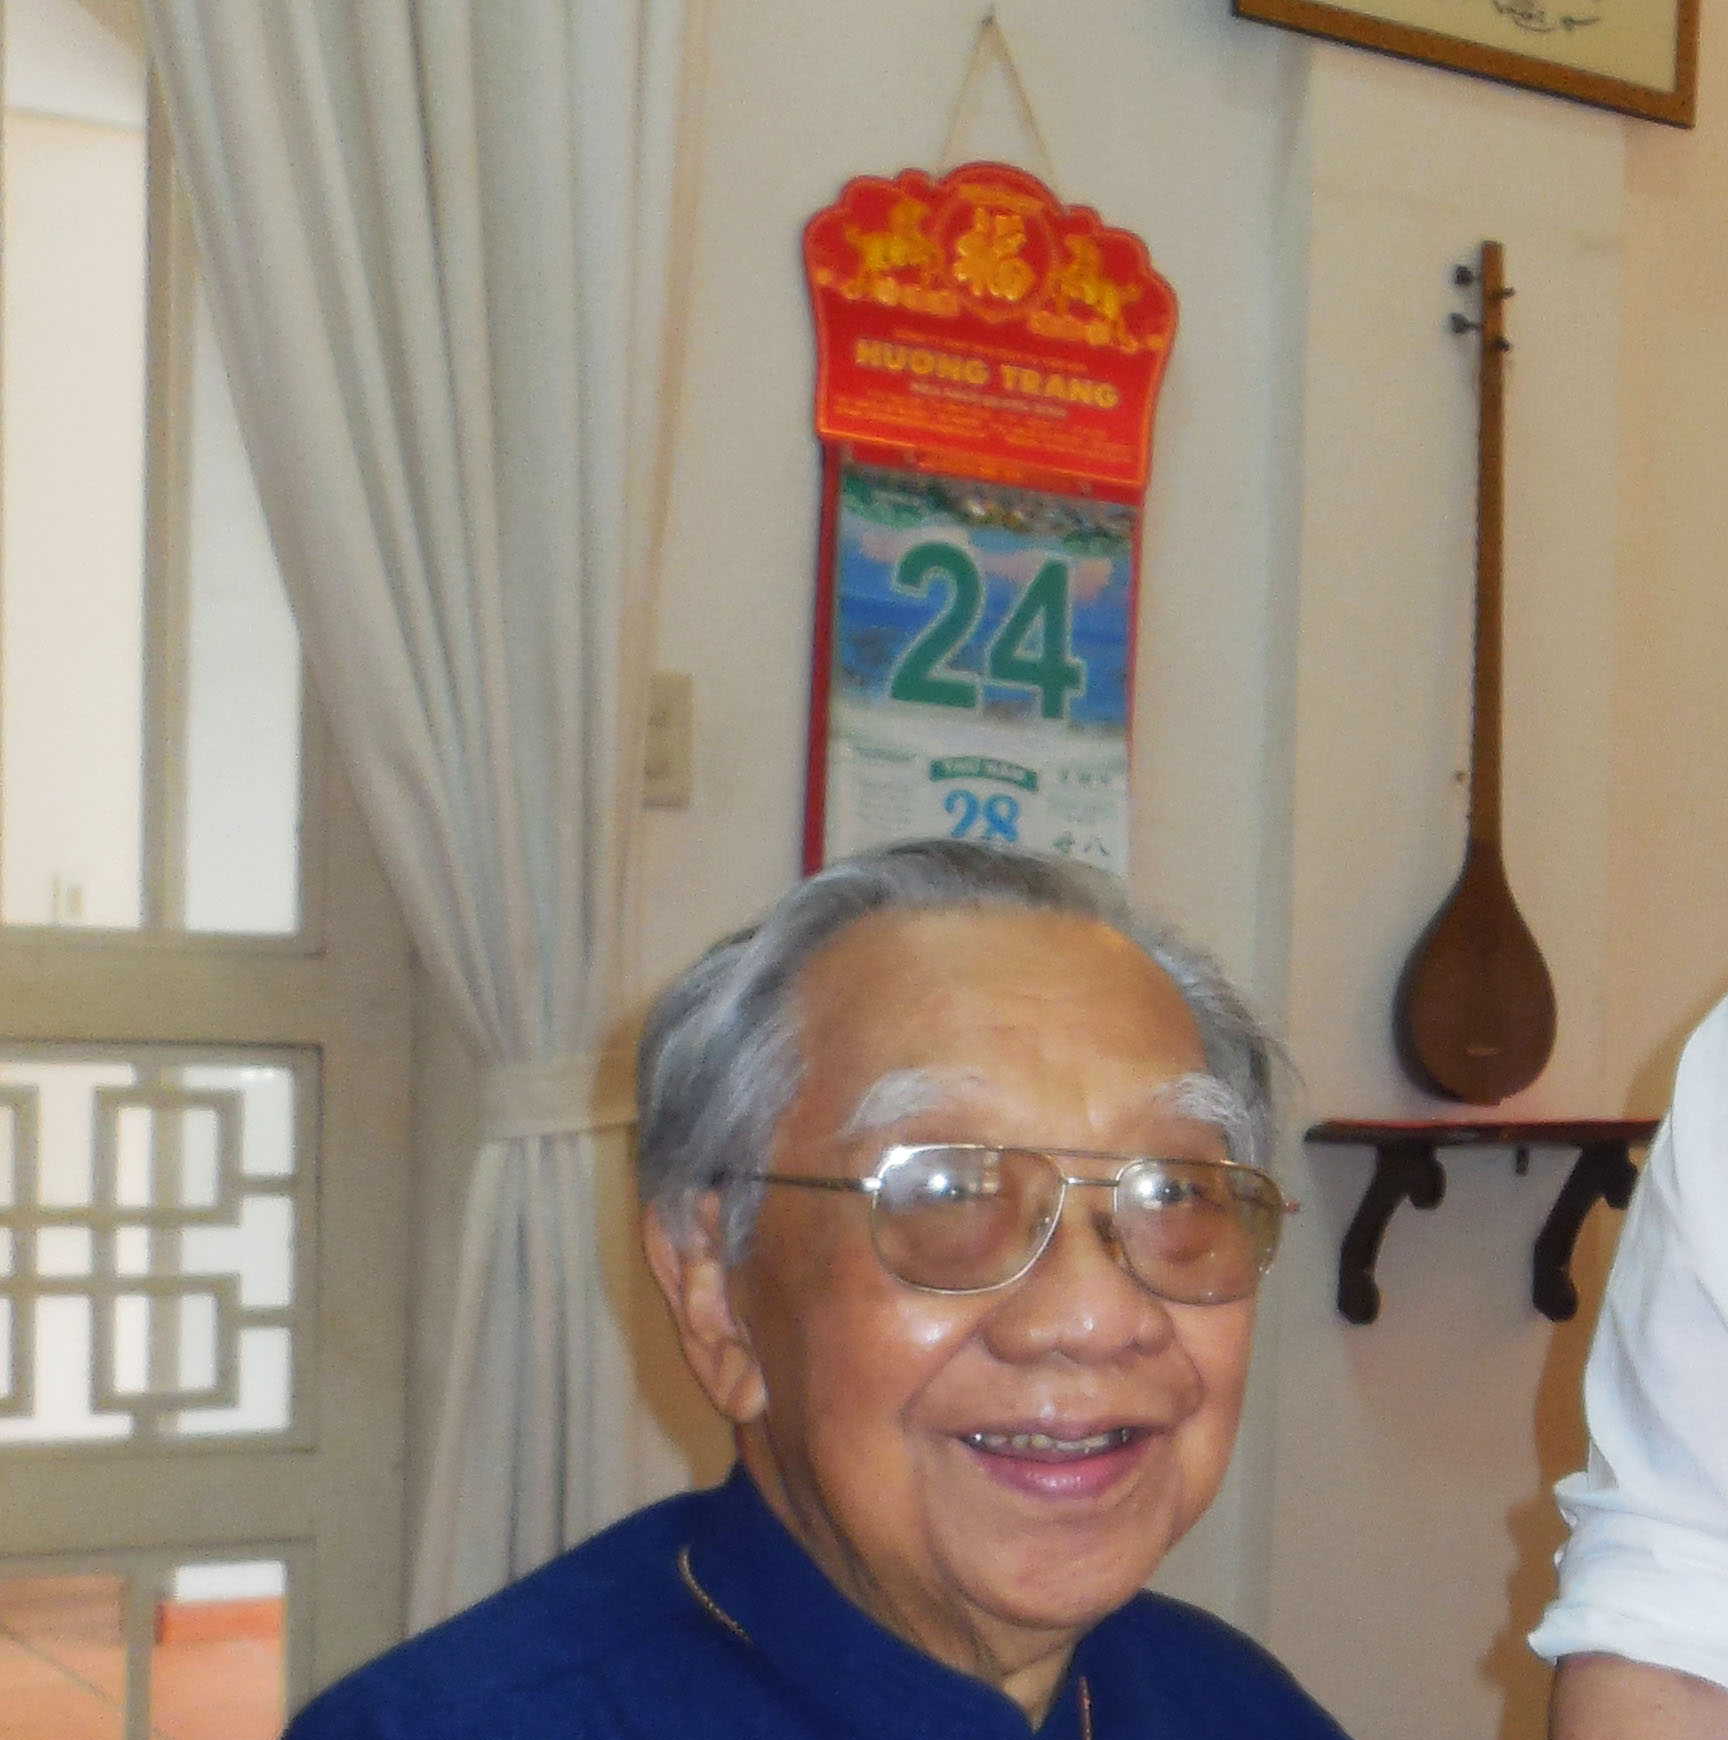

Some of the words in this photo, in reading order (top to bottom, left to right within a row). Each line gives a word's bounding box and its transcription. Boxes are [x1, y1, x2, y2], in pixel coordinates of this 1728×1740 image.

[1001, 364, 1119, 408] TRANG
[891, 541, 1084, 719] 24
[944, 789, 1019, 843] 28
